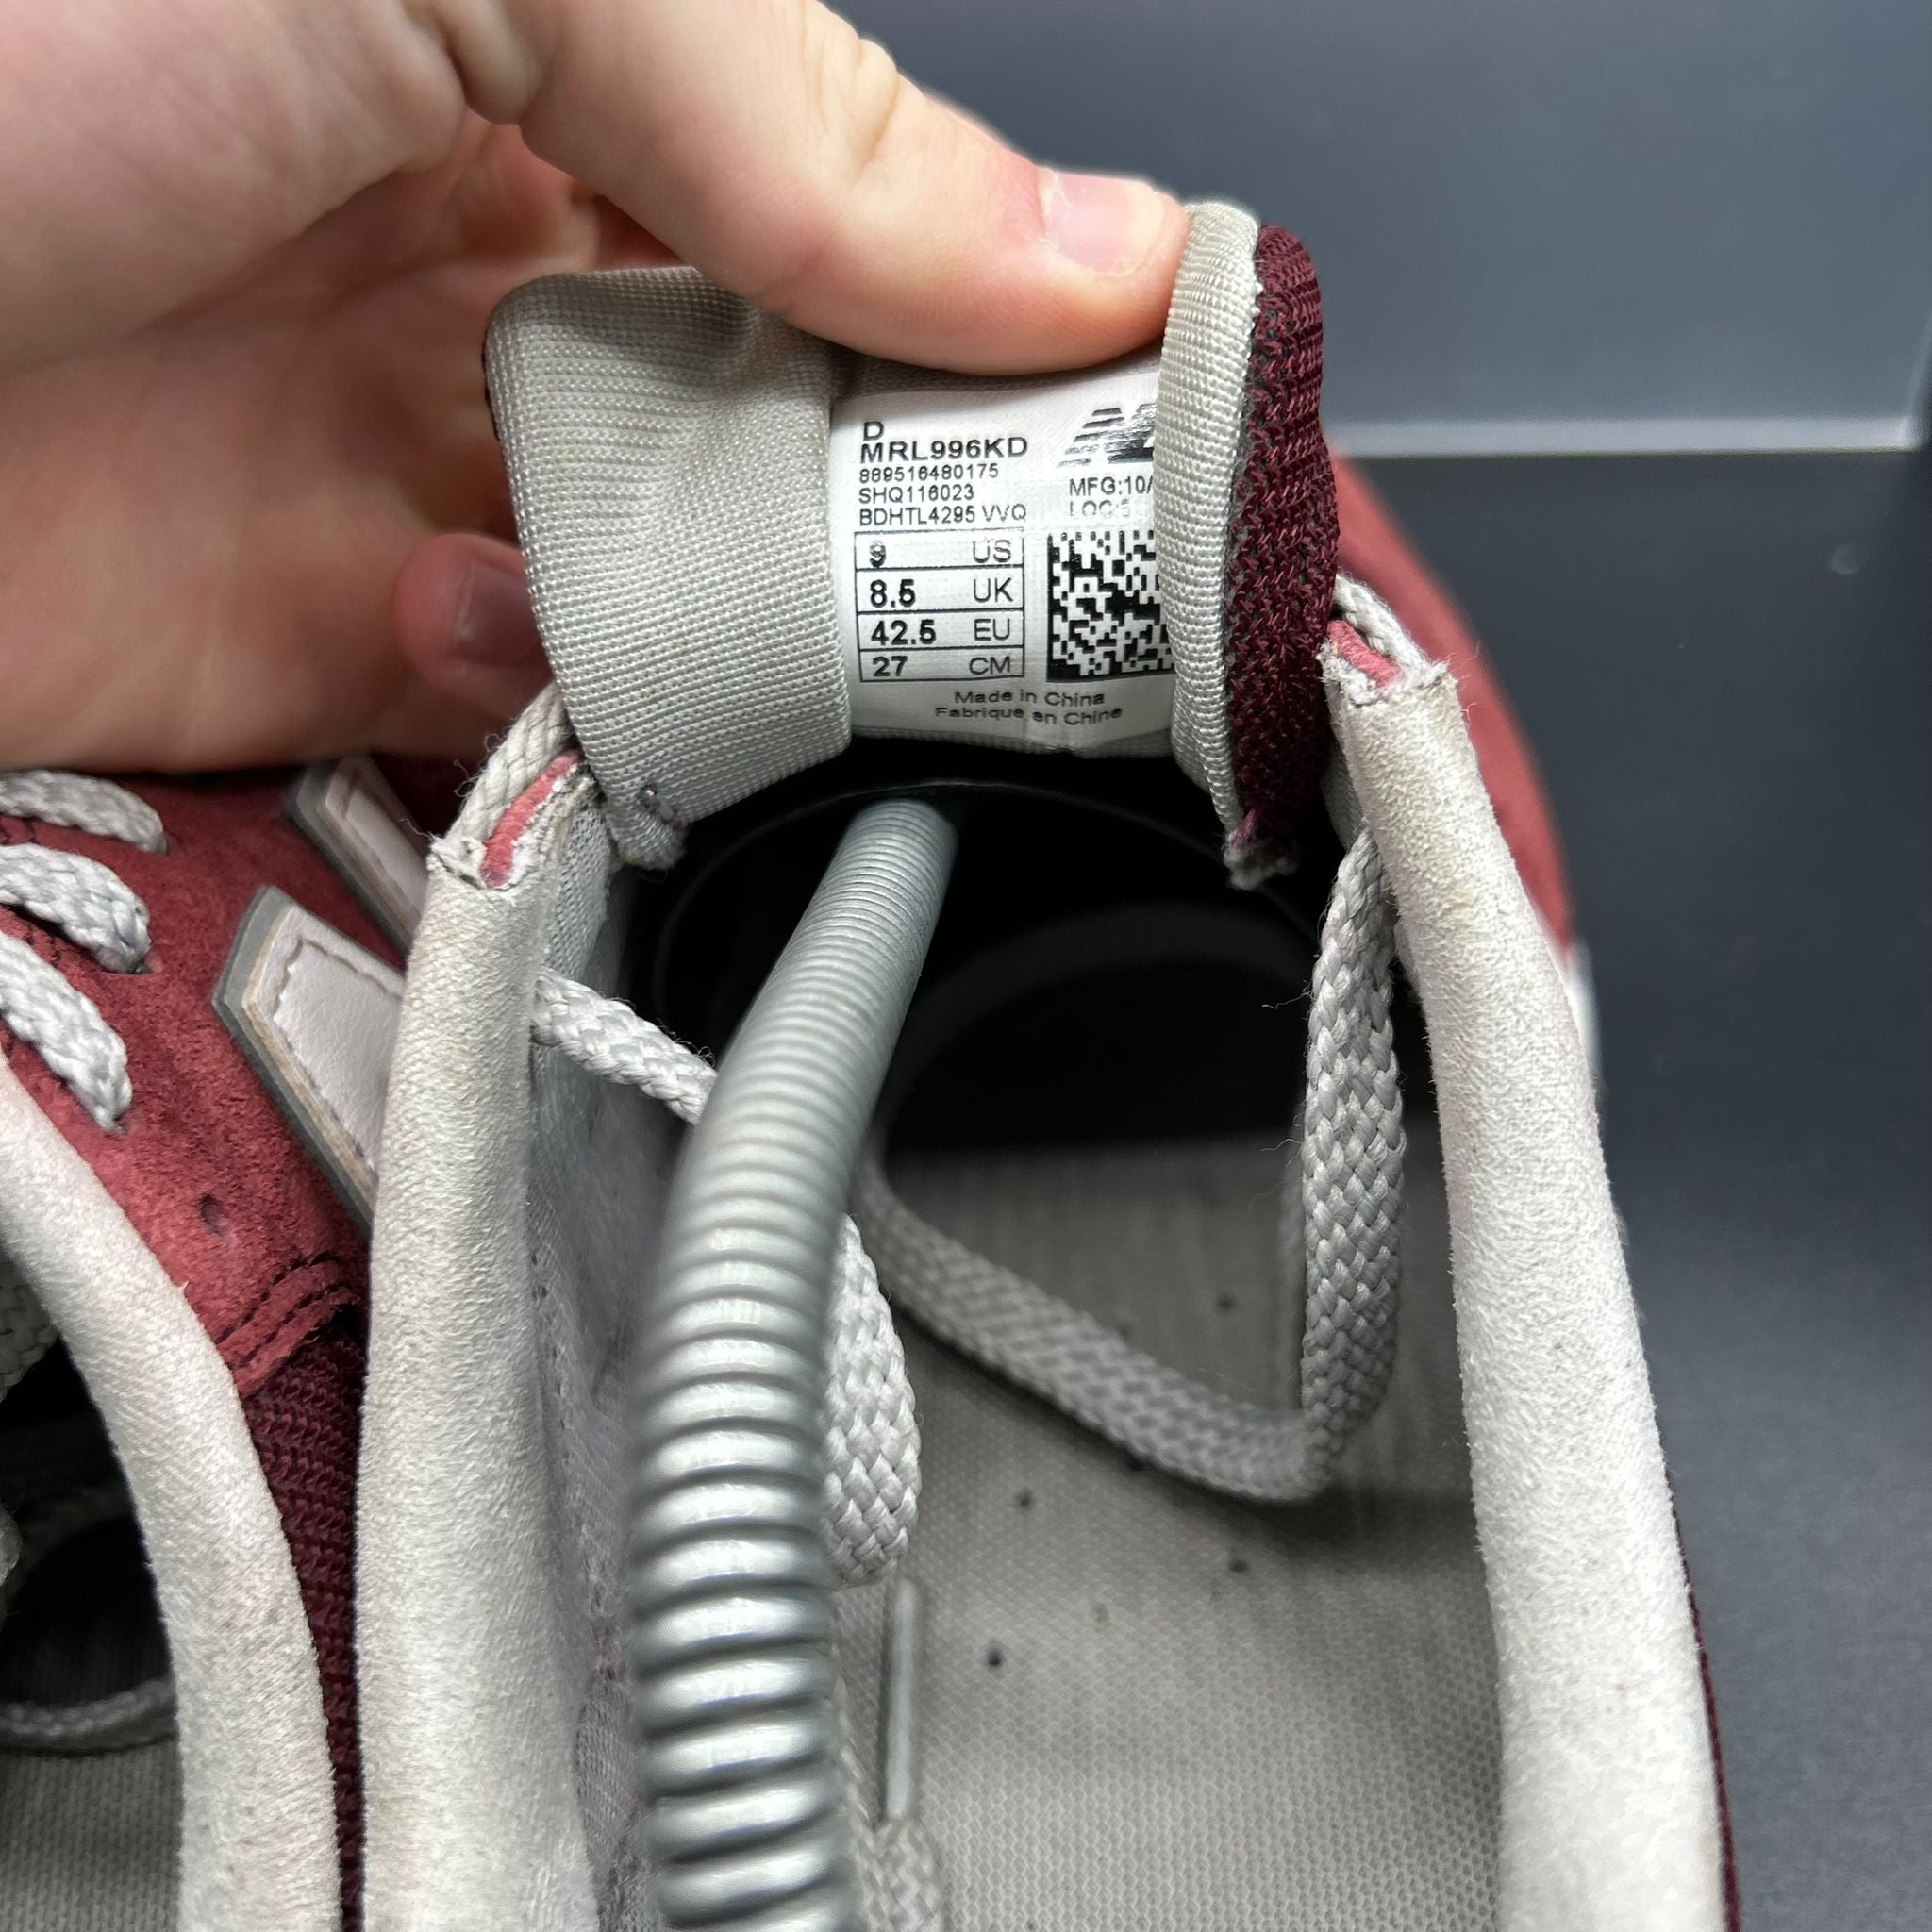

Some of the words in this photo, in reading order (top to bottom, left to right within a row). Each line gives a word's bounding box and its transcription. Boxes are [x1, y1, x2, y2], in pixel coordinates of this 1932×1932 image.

[862, 421, 885, 441] D
[859, 437, 1028, 464] MRL996KD
[858, 483, 974, 505] SHQ116023
[859, 506, 975, 526] BDHTL4295
[869, 539, 887, 568] 9
[973, 539, 1012, 564] US
[870, 578, 916, 608] 8.5
[973, 577, 1014, 604] UK
[871, 619, 937, 646] 42.5
[974, 618, 1010, 641] EU
[872, 655, 908, 677] 27
[969, 656, 1011, 675] CM
[954, 690, 1013, 704] Made
[1019, 689, 1038, 704] in
[1044, 691, 1106, 708] China
[935, 708, 1024, 721] Fabrique
[1032, 710, 1058, 724] en
[1063, 708, 1123, 725] Chine
